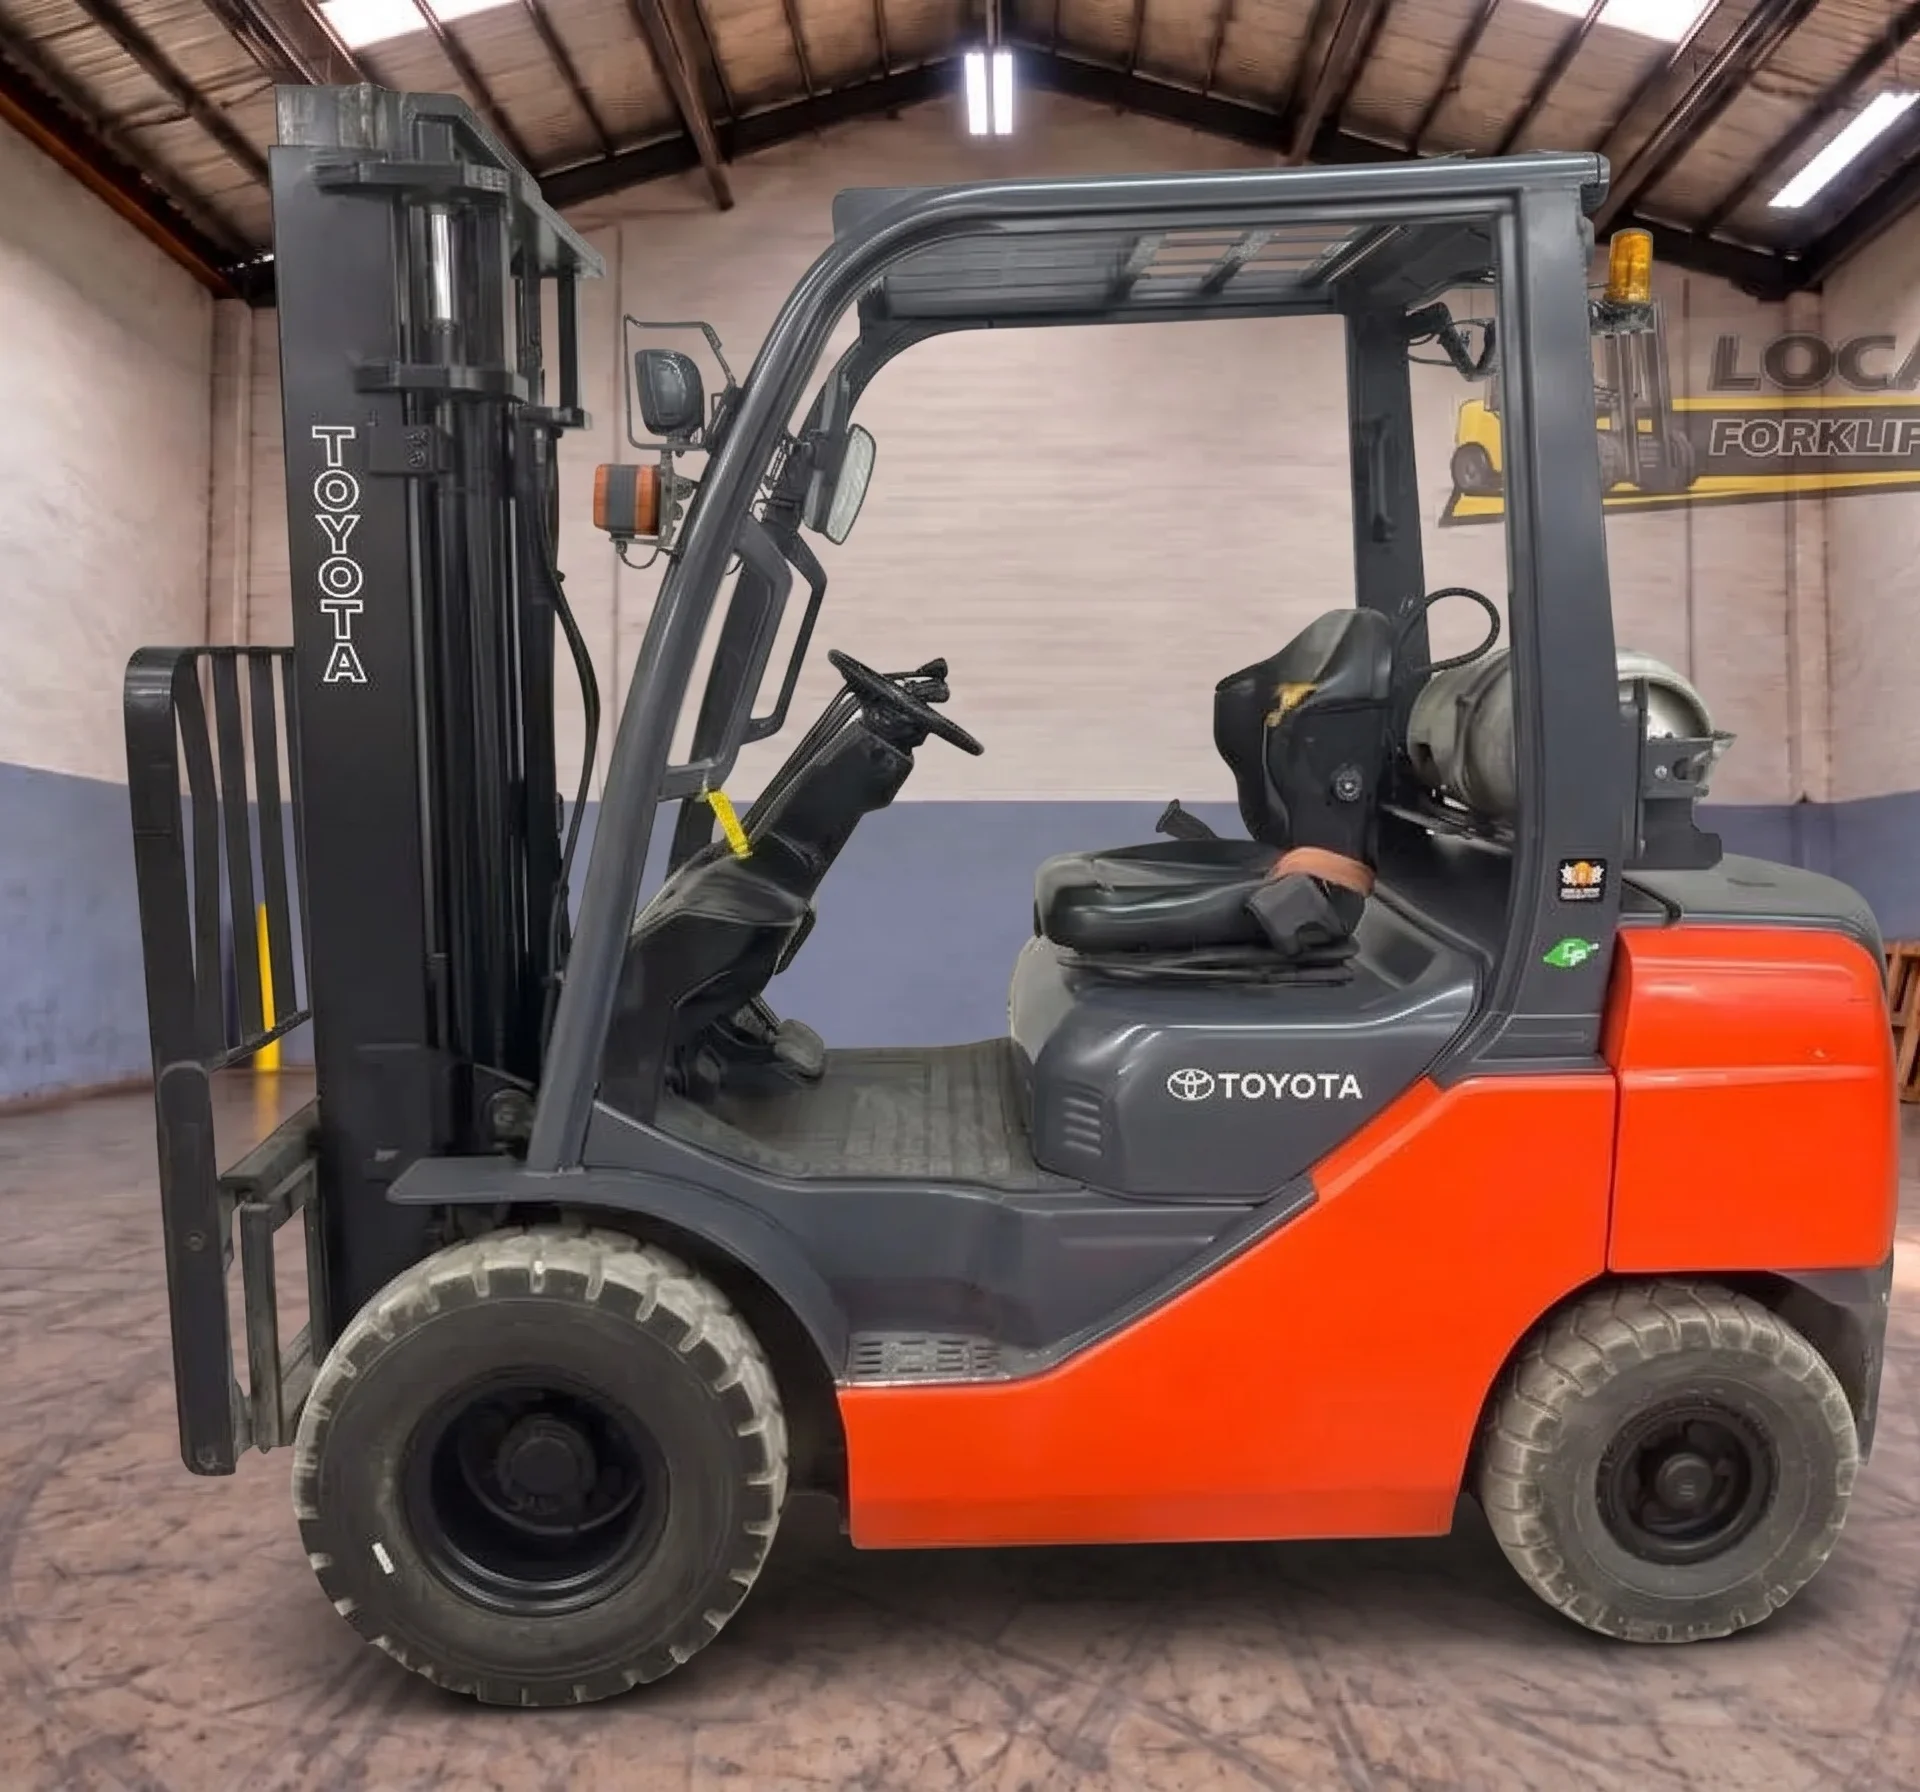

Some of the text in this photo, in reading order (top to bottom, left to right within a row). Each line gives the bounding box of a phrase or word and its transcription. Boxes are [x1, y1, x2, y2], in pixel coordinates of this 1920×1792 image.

[1709, 418, 1920, 457] FORKLIF
[312, 425, 367, 683] TOYOTA
[1218, 1073, 1363, 1099] TOYOTA
